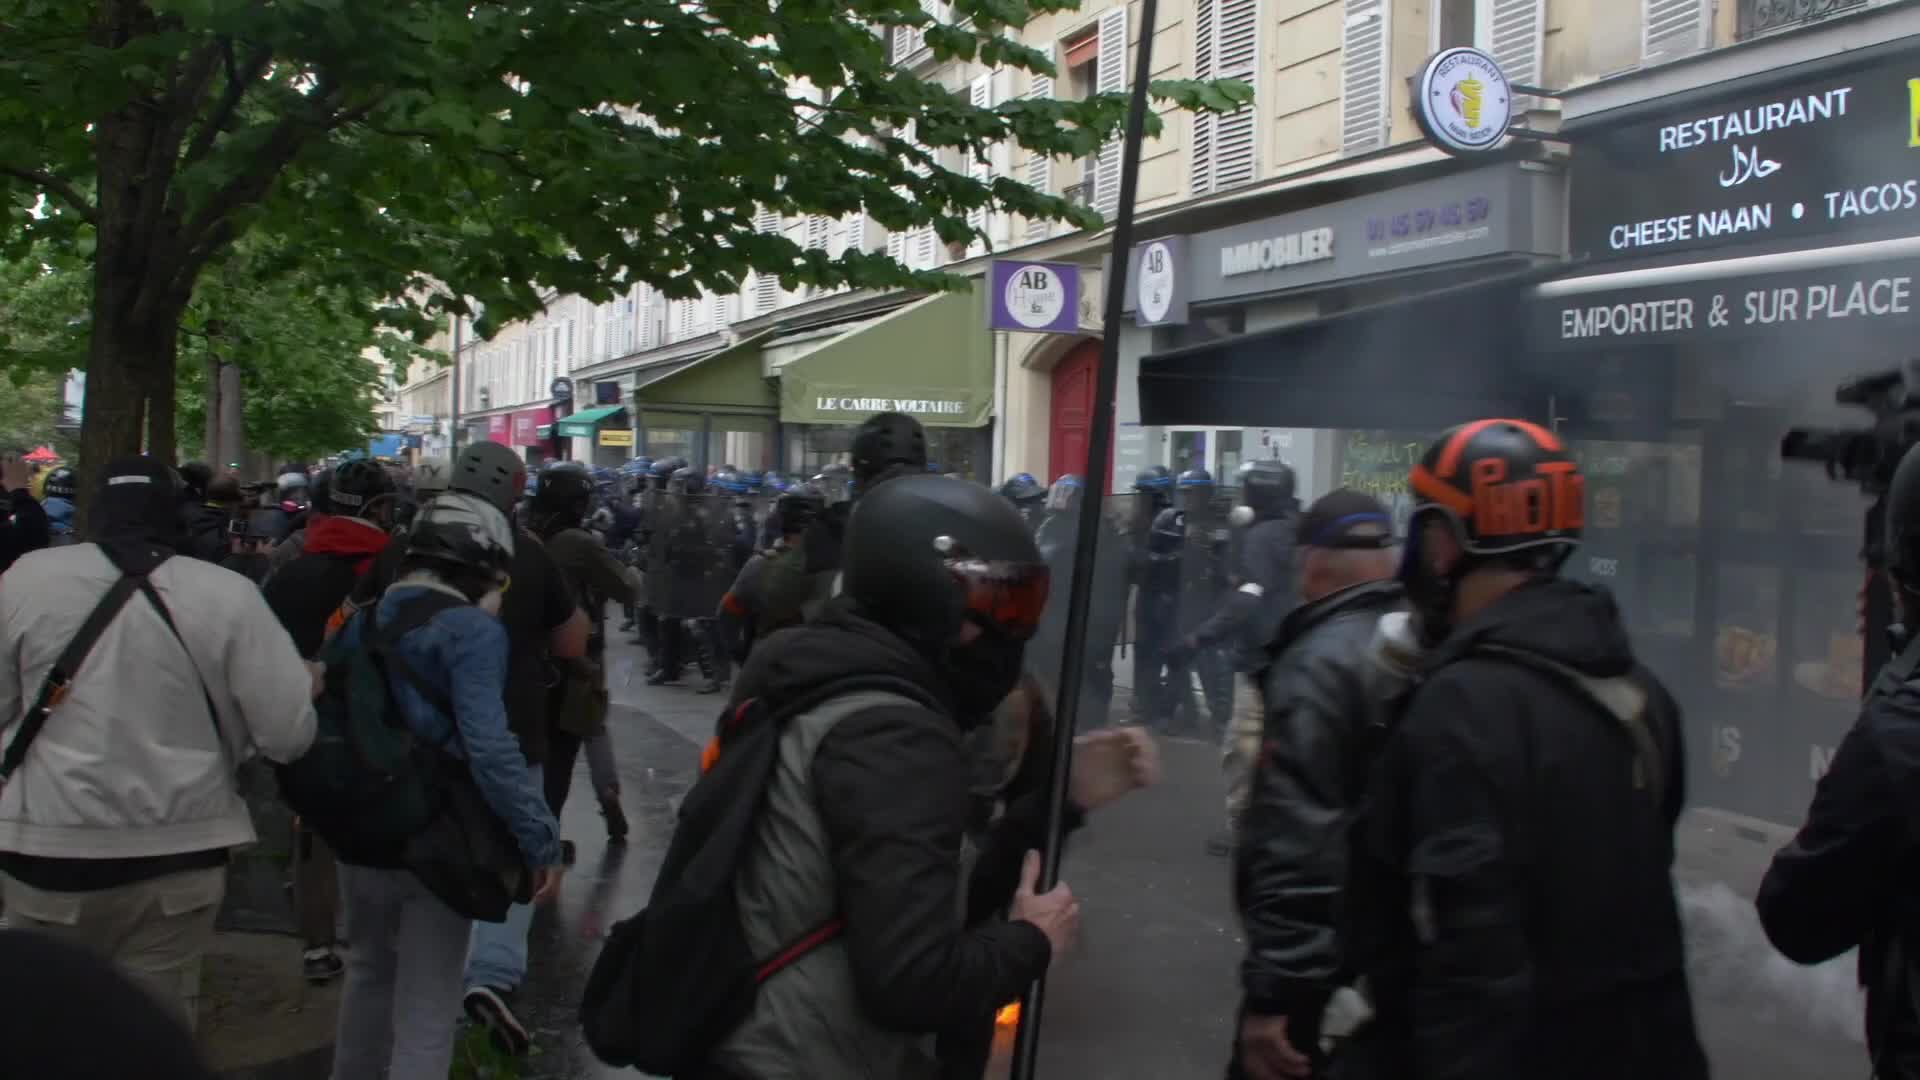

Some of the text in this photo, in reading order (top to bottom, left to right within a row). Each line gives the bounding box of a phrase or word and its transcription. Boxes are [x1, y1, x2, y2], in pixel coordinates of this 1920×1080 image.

[1439, 55, 1500, 81] RESTAURANT
[1659, 87, 1851, 152] RESTAURANT
[1609, 180, 1918, 251] CHEESE NAAN TACOS
[1148, 249, 1163, 274] AB
[1219, 226, 1335, 277] IMMOBILIER
[1019, 270, 1048, 290] AB
[1561, 277, 1911, 340] EMPORTER & SUR PLACE
[815, 397, 837, 410] LE
[894, 399, 965, 413] VOLTAIRE
